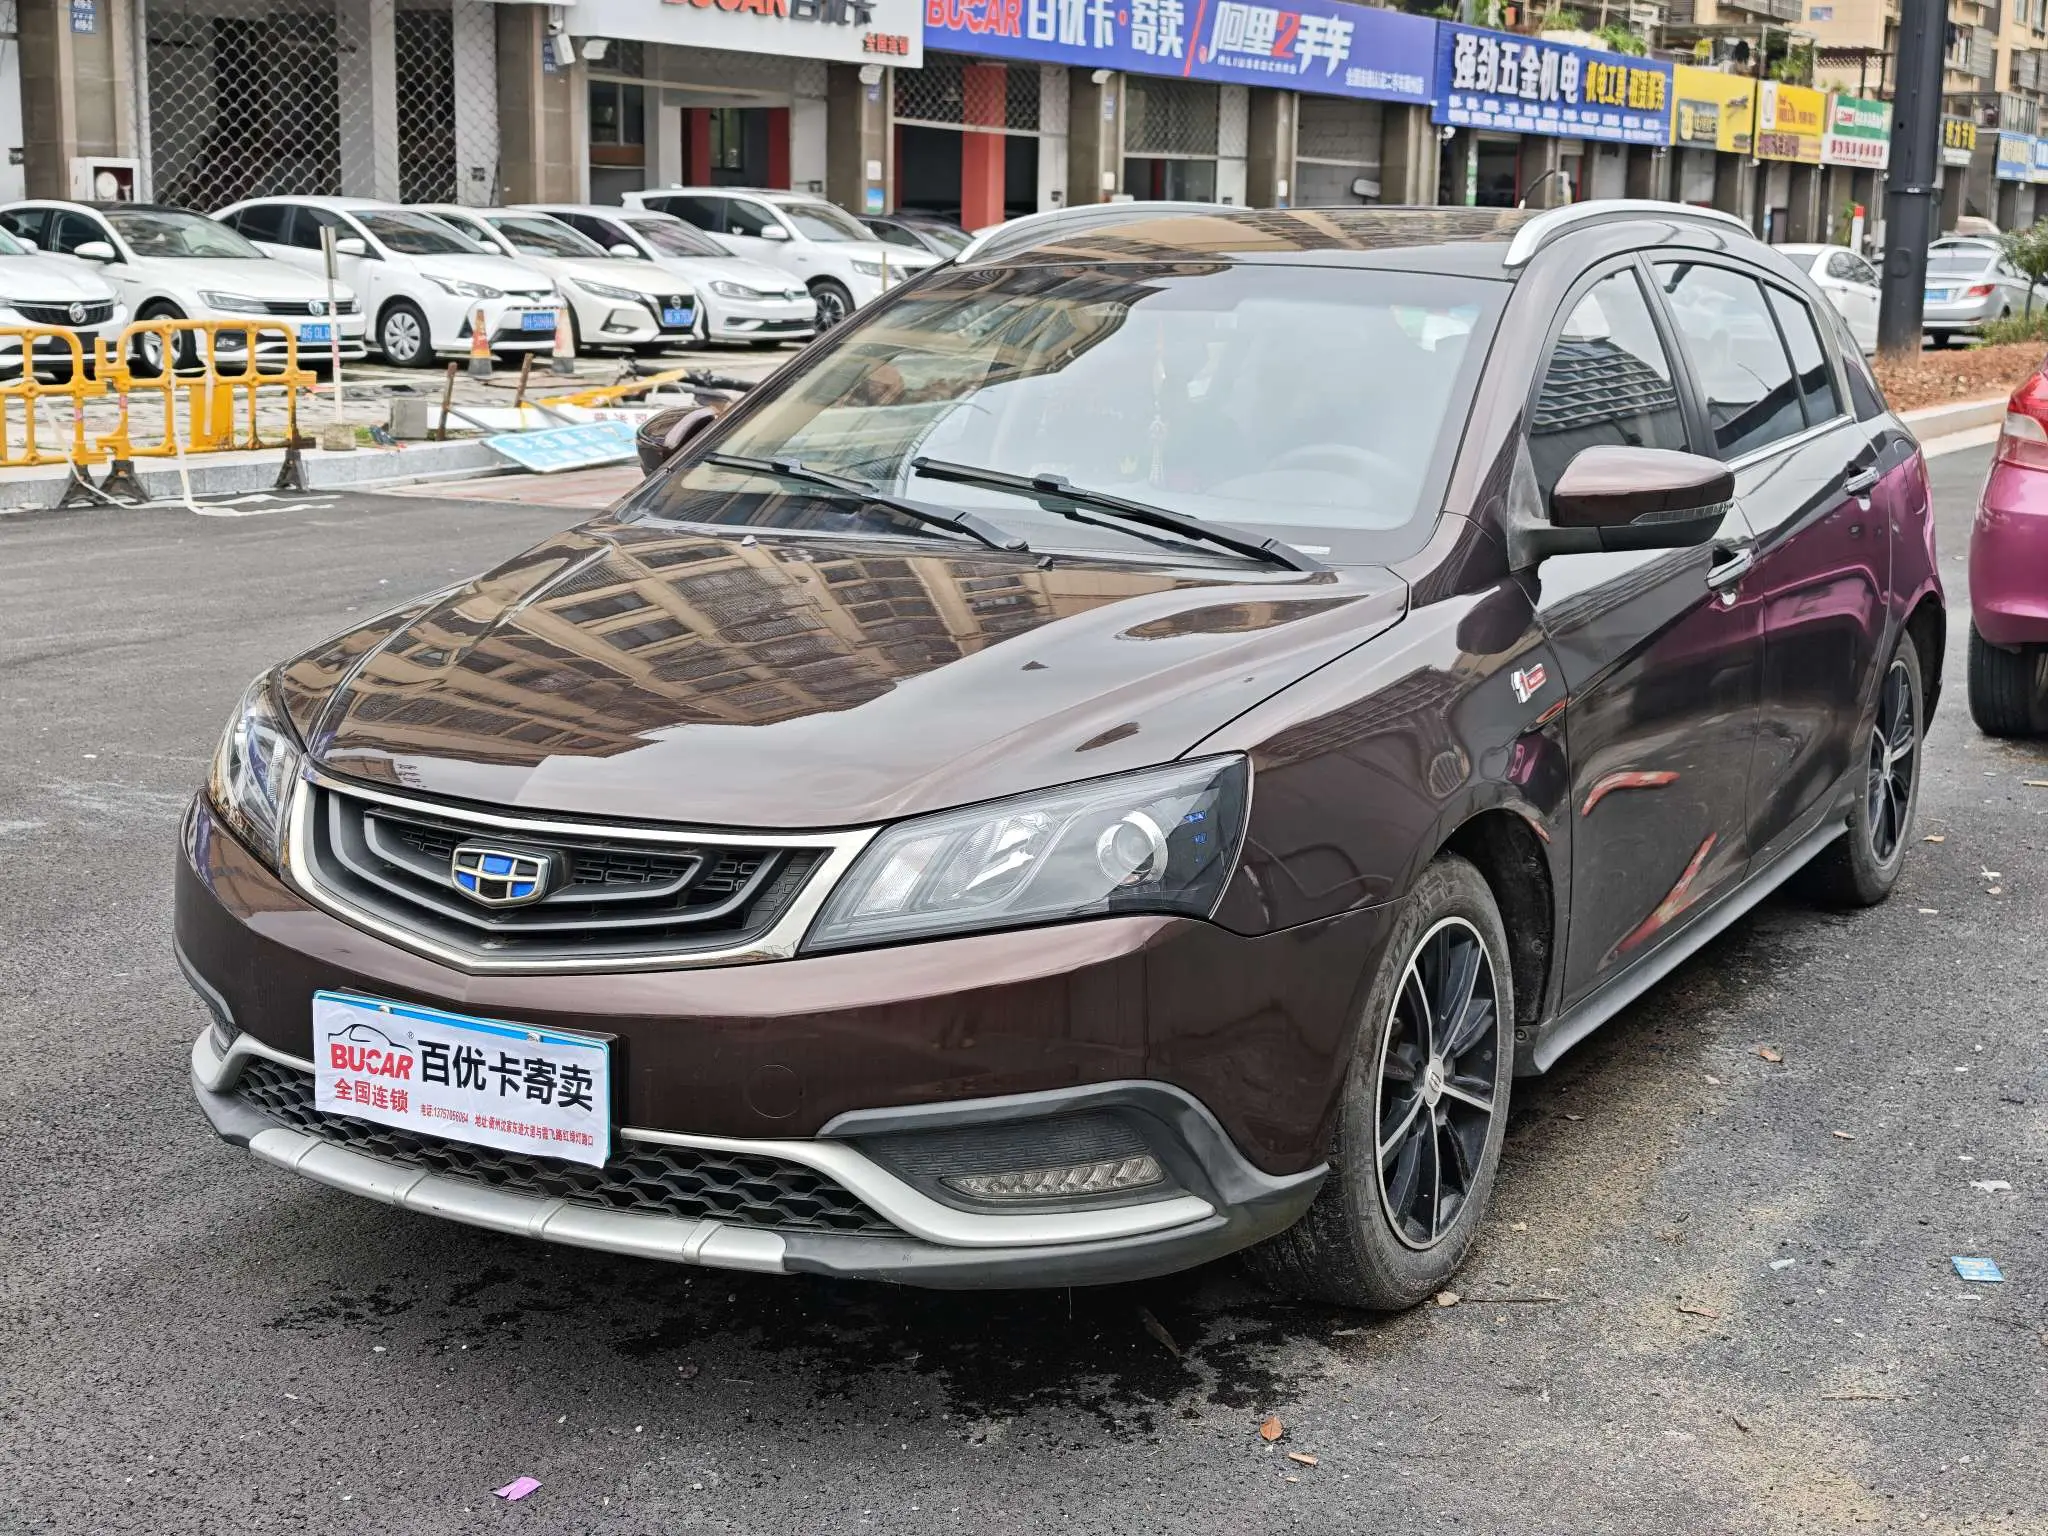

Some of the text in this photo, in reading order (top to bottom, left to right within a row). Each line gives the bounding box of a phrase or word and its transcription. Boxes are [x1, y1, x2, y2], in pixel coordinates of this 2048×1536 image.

[1453, 32, 1580, 104] 强劲五金机电
[330, 1043, 414, 1080] BUCAR
[417, 1039, 593, 1113] 百优卡寄卖
[334, 1077, 409, 1114] 全国连锁
